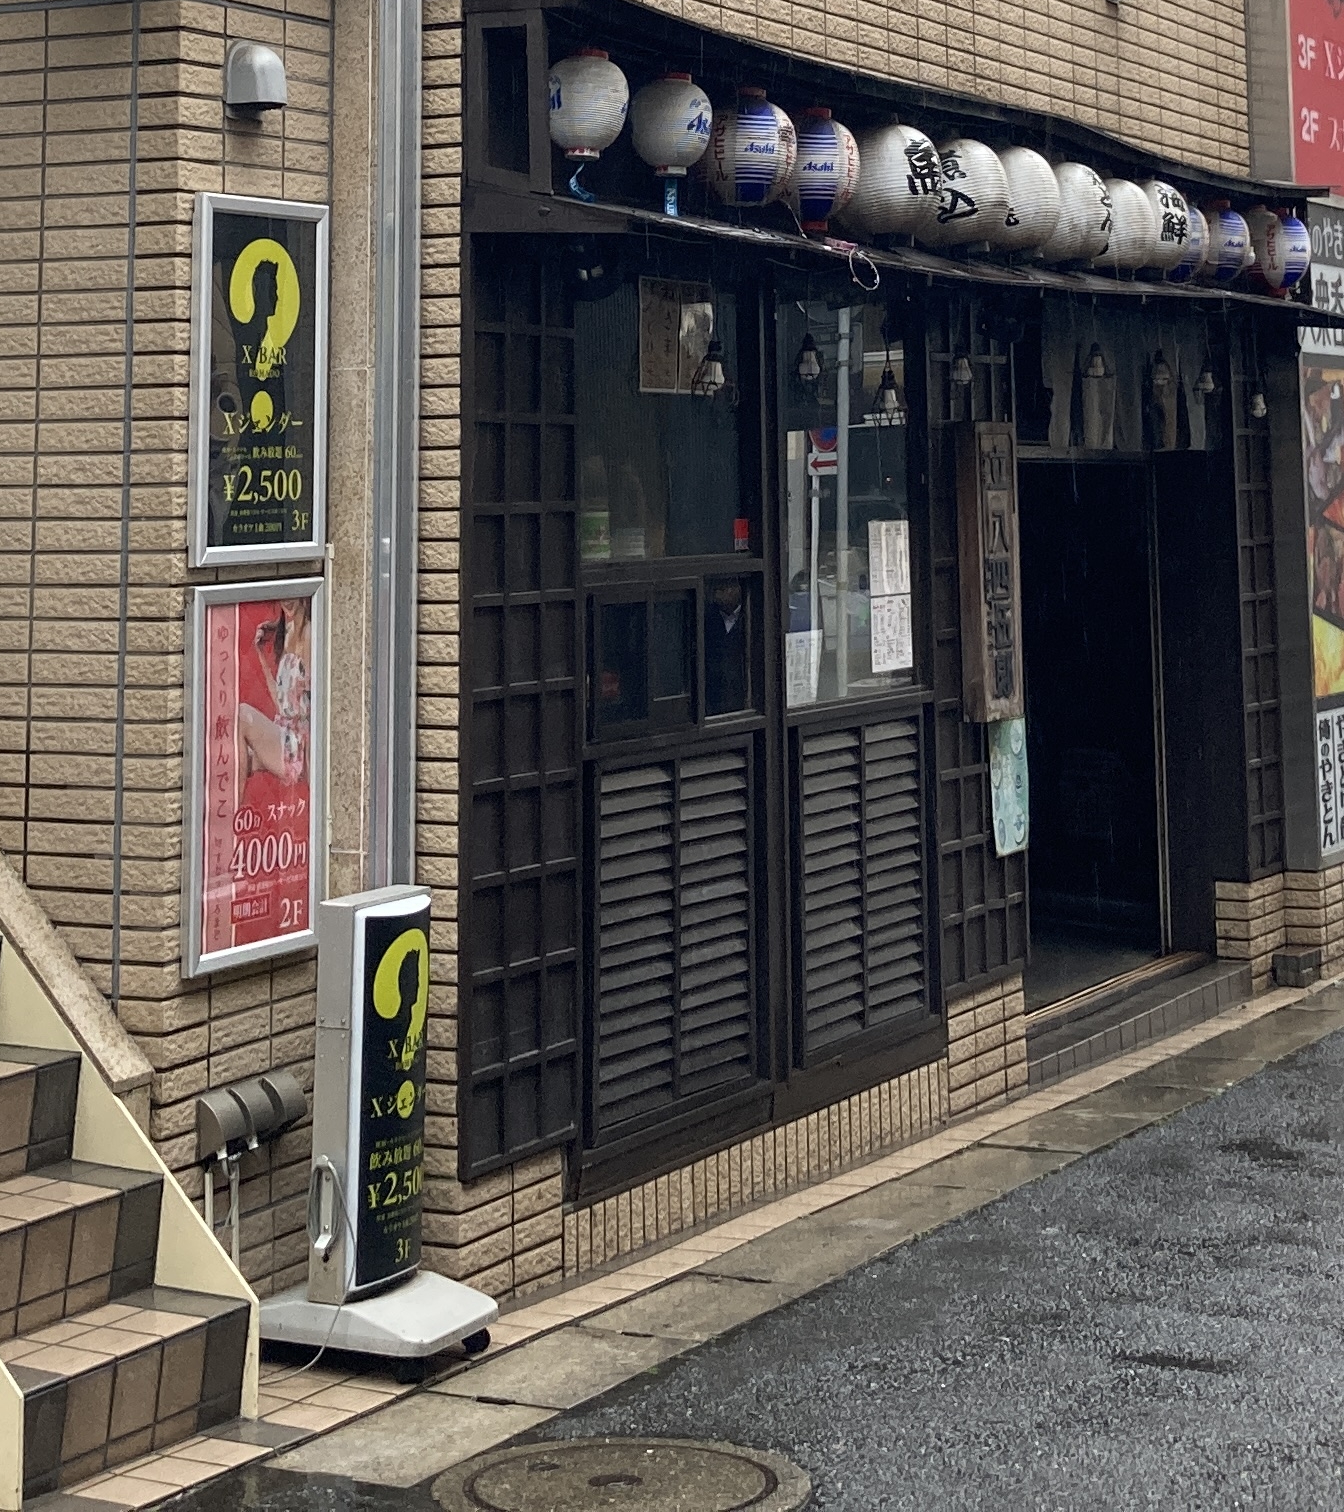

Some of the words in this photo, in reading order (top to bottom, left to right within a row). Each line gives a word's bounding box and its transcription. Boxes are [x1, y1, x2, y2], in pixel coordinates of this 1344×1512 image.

[1298, 34, 1317, 70] 3F
[1301, 107, 1320, 144] 2F
[803, 161, 834, 172] Asahi
[241, 345, 253, 365] X
[258, 345, 288, 365] BAR
[223, 465, 302, 505] ¥2,500
[291, 509, 309, 531] 3F
[214, 625, 230, 819] ゆっくり飲んでこ
[267, 798, 306, 822] スナック
[230, 832, 306, 879] 4000円
[279, 897, 304, 928] 2F
